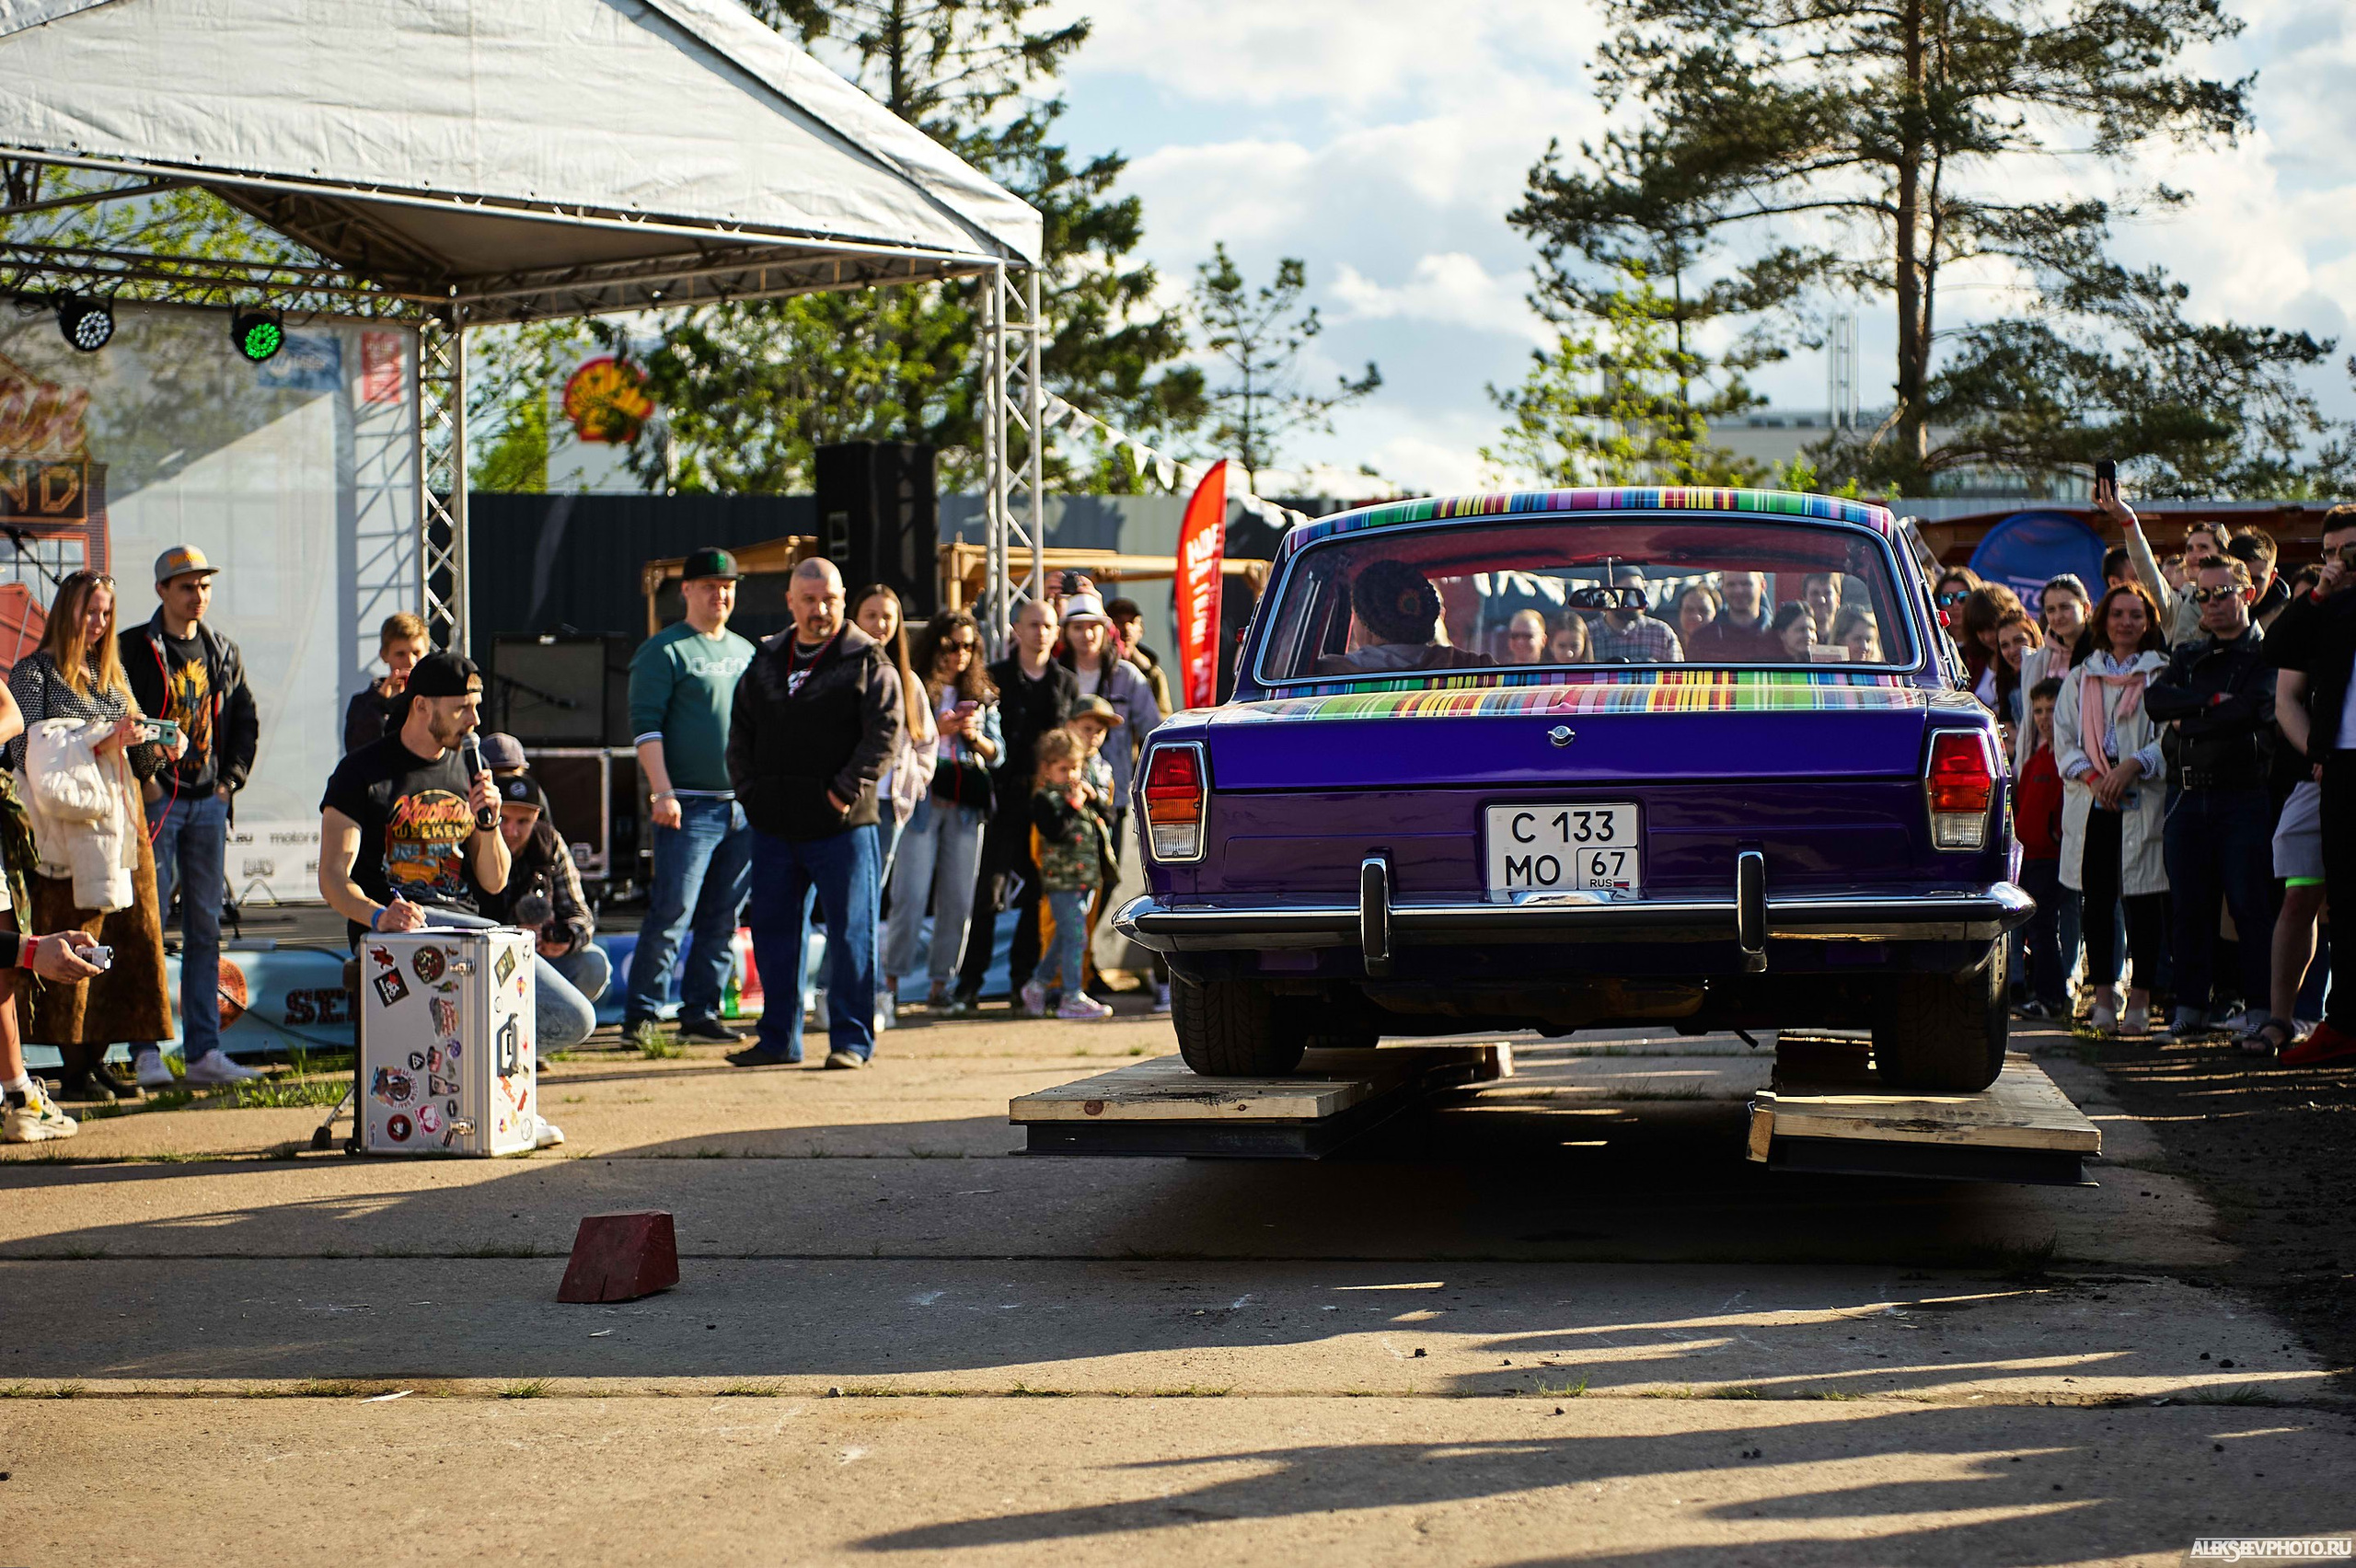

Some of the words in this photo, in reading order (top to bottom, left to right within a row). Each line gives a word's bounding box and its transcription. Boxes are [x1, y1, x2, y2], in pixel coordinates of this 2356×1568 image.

[1511, 812, 1536, 844] С
[1552, 810, 1614, 843] 133
[1505, 854, 1561, 886] МО
[1590, 851, 1625, 876] 67
[1589, 878, 1612, 888] RUS
[283, 987, 355, 1026] SE
